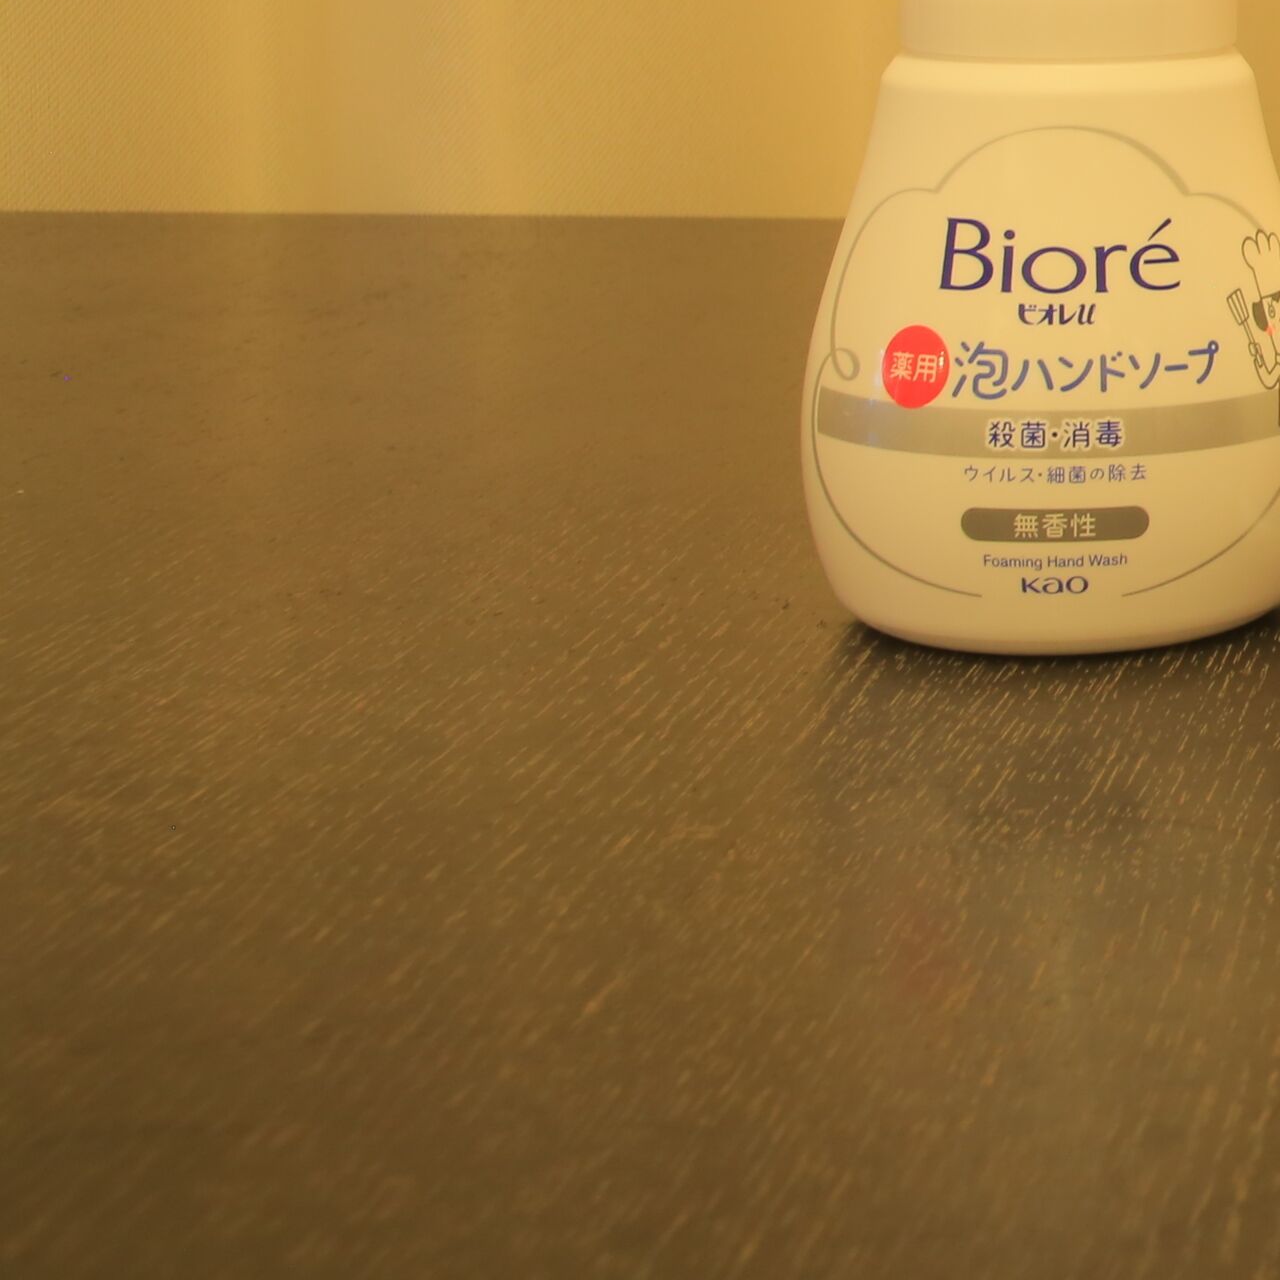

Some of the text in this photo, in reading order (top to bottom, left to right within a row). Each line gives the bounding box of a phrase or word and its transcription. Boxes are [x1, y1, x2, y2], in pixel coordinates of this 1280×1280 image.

[939, 217, 1181, 294] Bioré
[889, 351, 938, 383] 薬用
[952, 339, 1220, 401] 泡ハンドソープ
[988, 420, 1123, 449] 殺菌・消毒
[963, 463, 1147, 484] ウイルス・細菌の除去
[1013, 513, 1096, 538] 無香性
[983, 552, 1128, 571] Foaming Hand Wash
